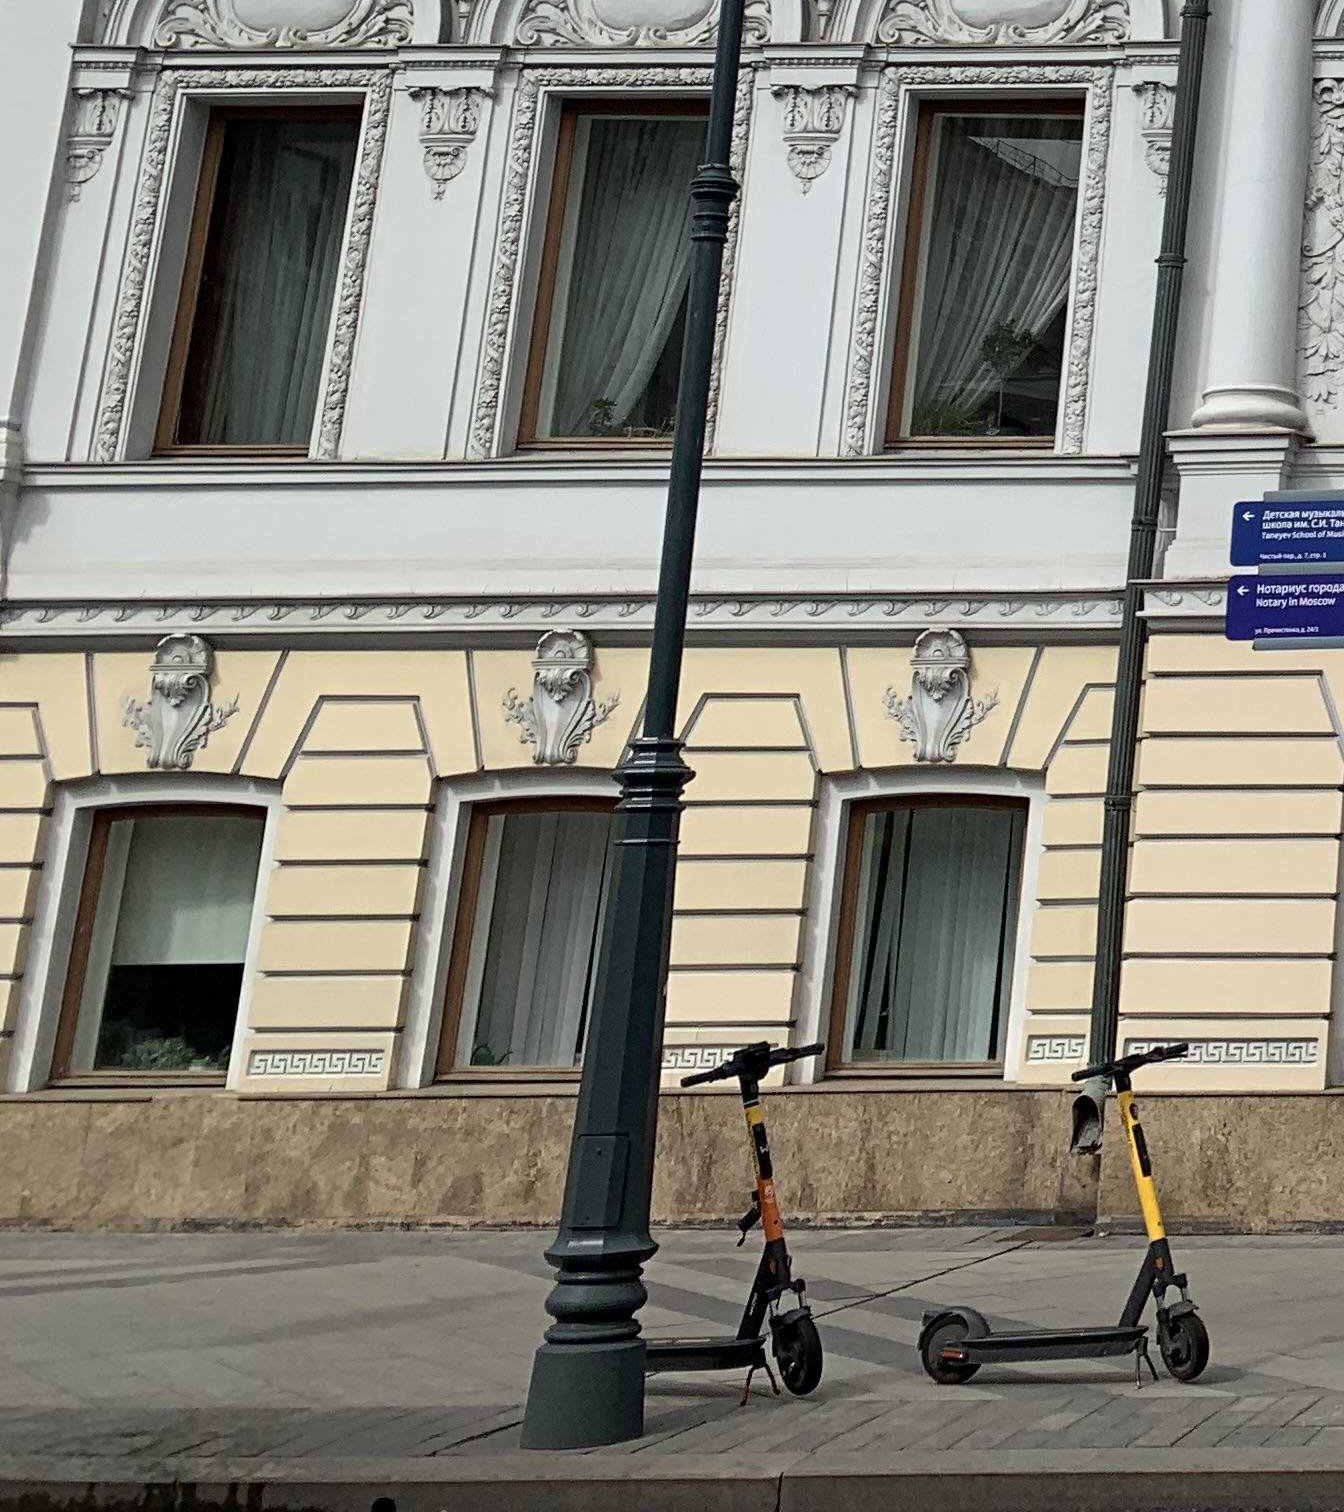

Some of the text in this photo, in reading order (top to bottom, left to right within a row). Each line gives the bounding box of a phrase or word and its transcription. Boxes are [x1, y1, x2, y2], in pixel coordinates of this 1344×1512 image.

[1262, 510, 1300, 520] Детская
[1262, 520, 1292, 529] школа
[1294, 520, 1310, 528] им.
[1311, 520, 1328, 528] С.И.
[1262, 532, 1291, 540] Taneyev
[1318, 530, 1326, 538] of
[1256, 584, 1307, 595] Нотариус
[1309, 583, 1344, 595] города
[1256, 597, 1336, 609] Notary in Moscow
